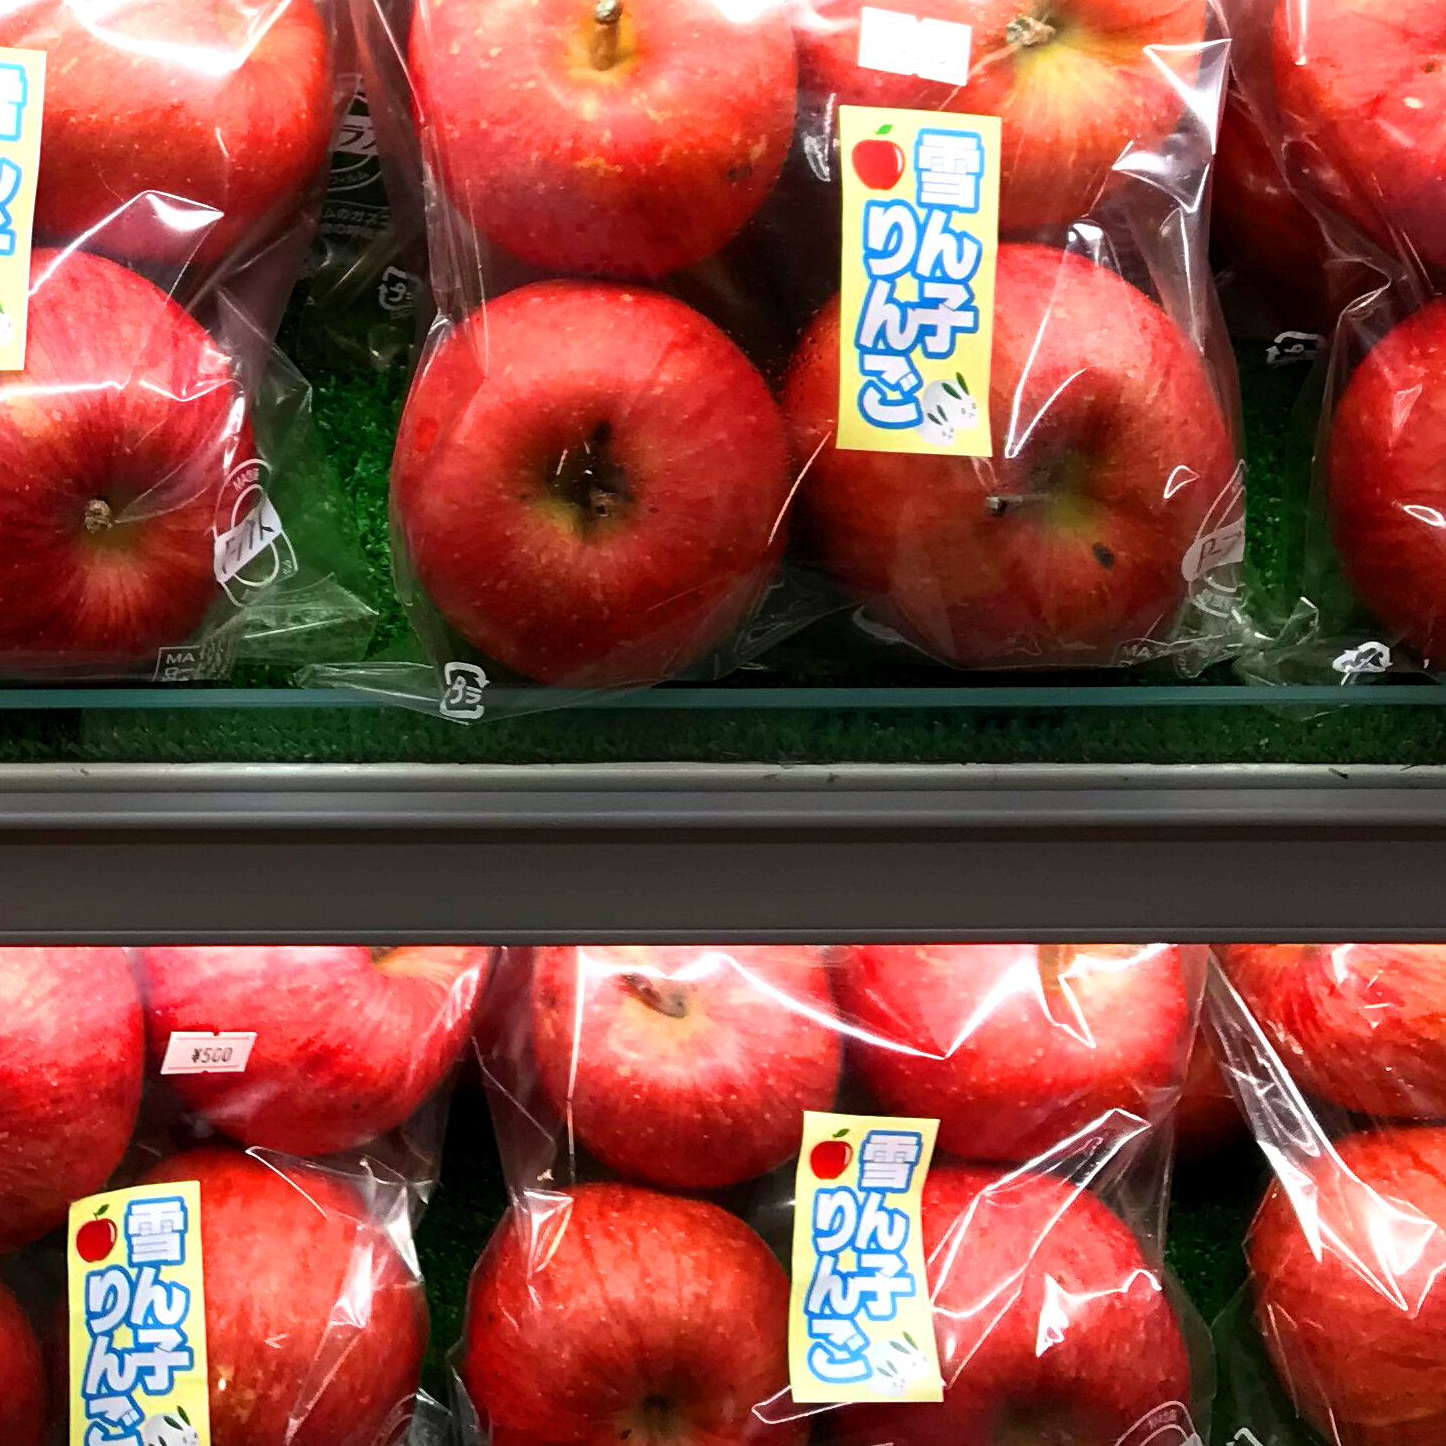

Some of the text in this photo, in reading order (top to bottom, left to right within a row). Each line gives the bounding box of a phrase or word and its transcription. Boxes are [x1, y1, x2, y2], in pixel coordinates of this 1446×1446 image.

[854, 199, 923, 430] りんご
[914, 127, 984, 359] 雪ん子
[191, 1047, 234, 1064] ¥500
[125, 1195, 194, 1395] 雪ん子
[804, 1186, 873, 1384] りんご
[854, 1129, 923, 1321] 雪ん子
